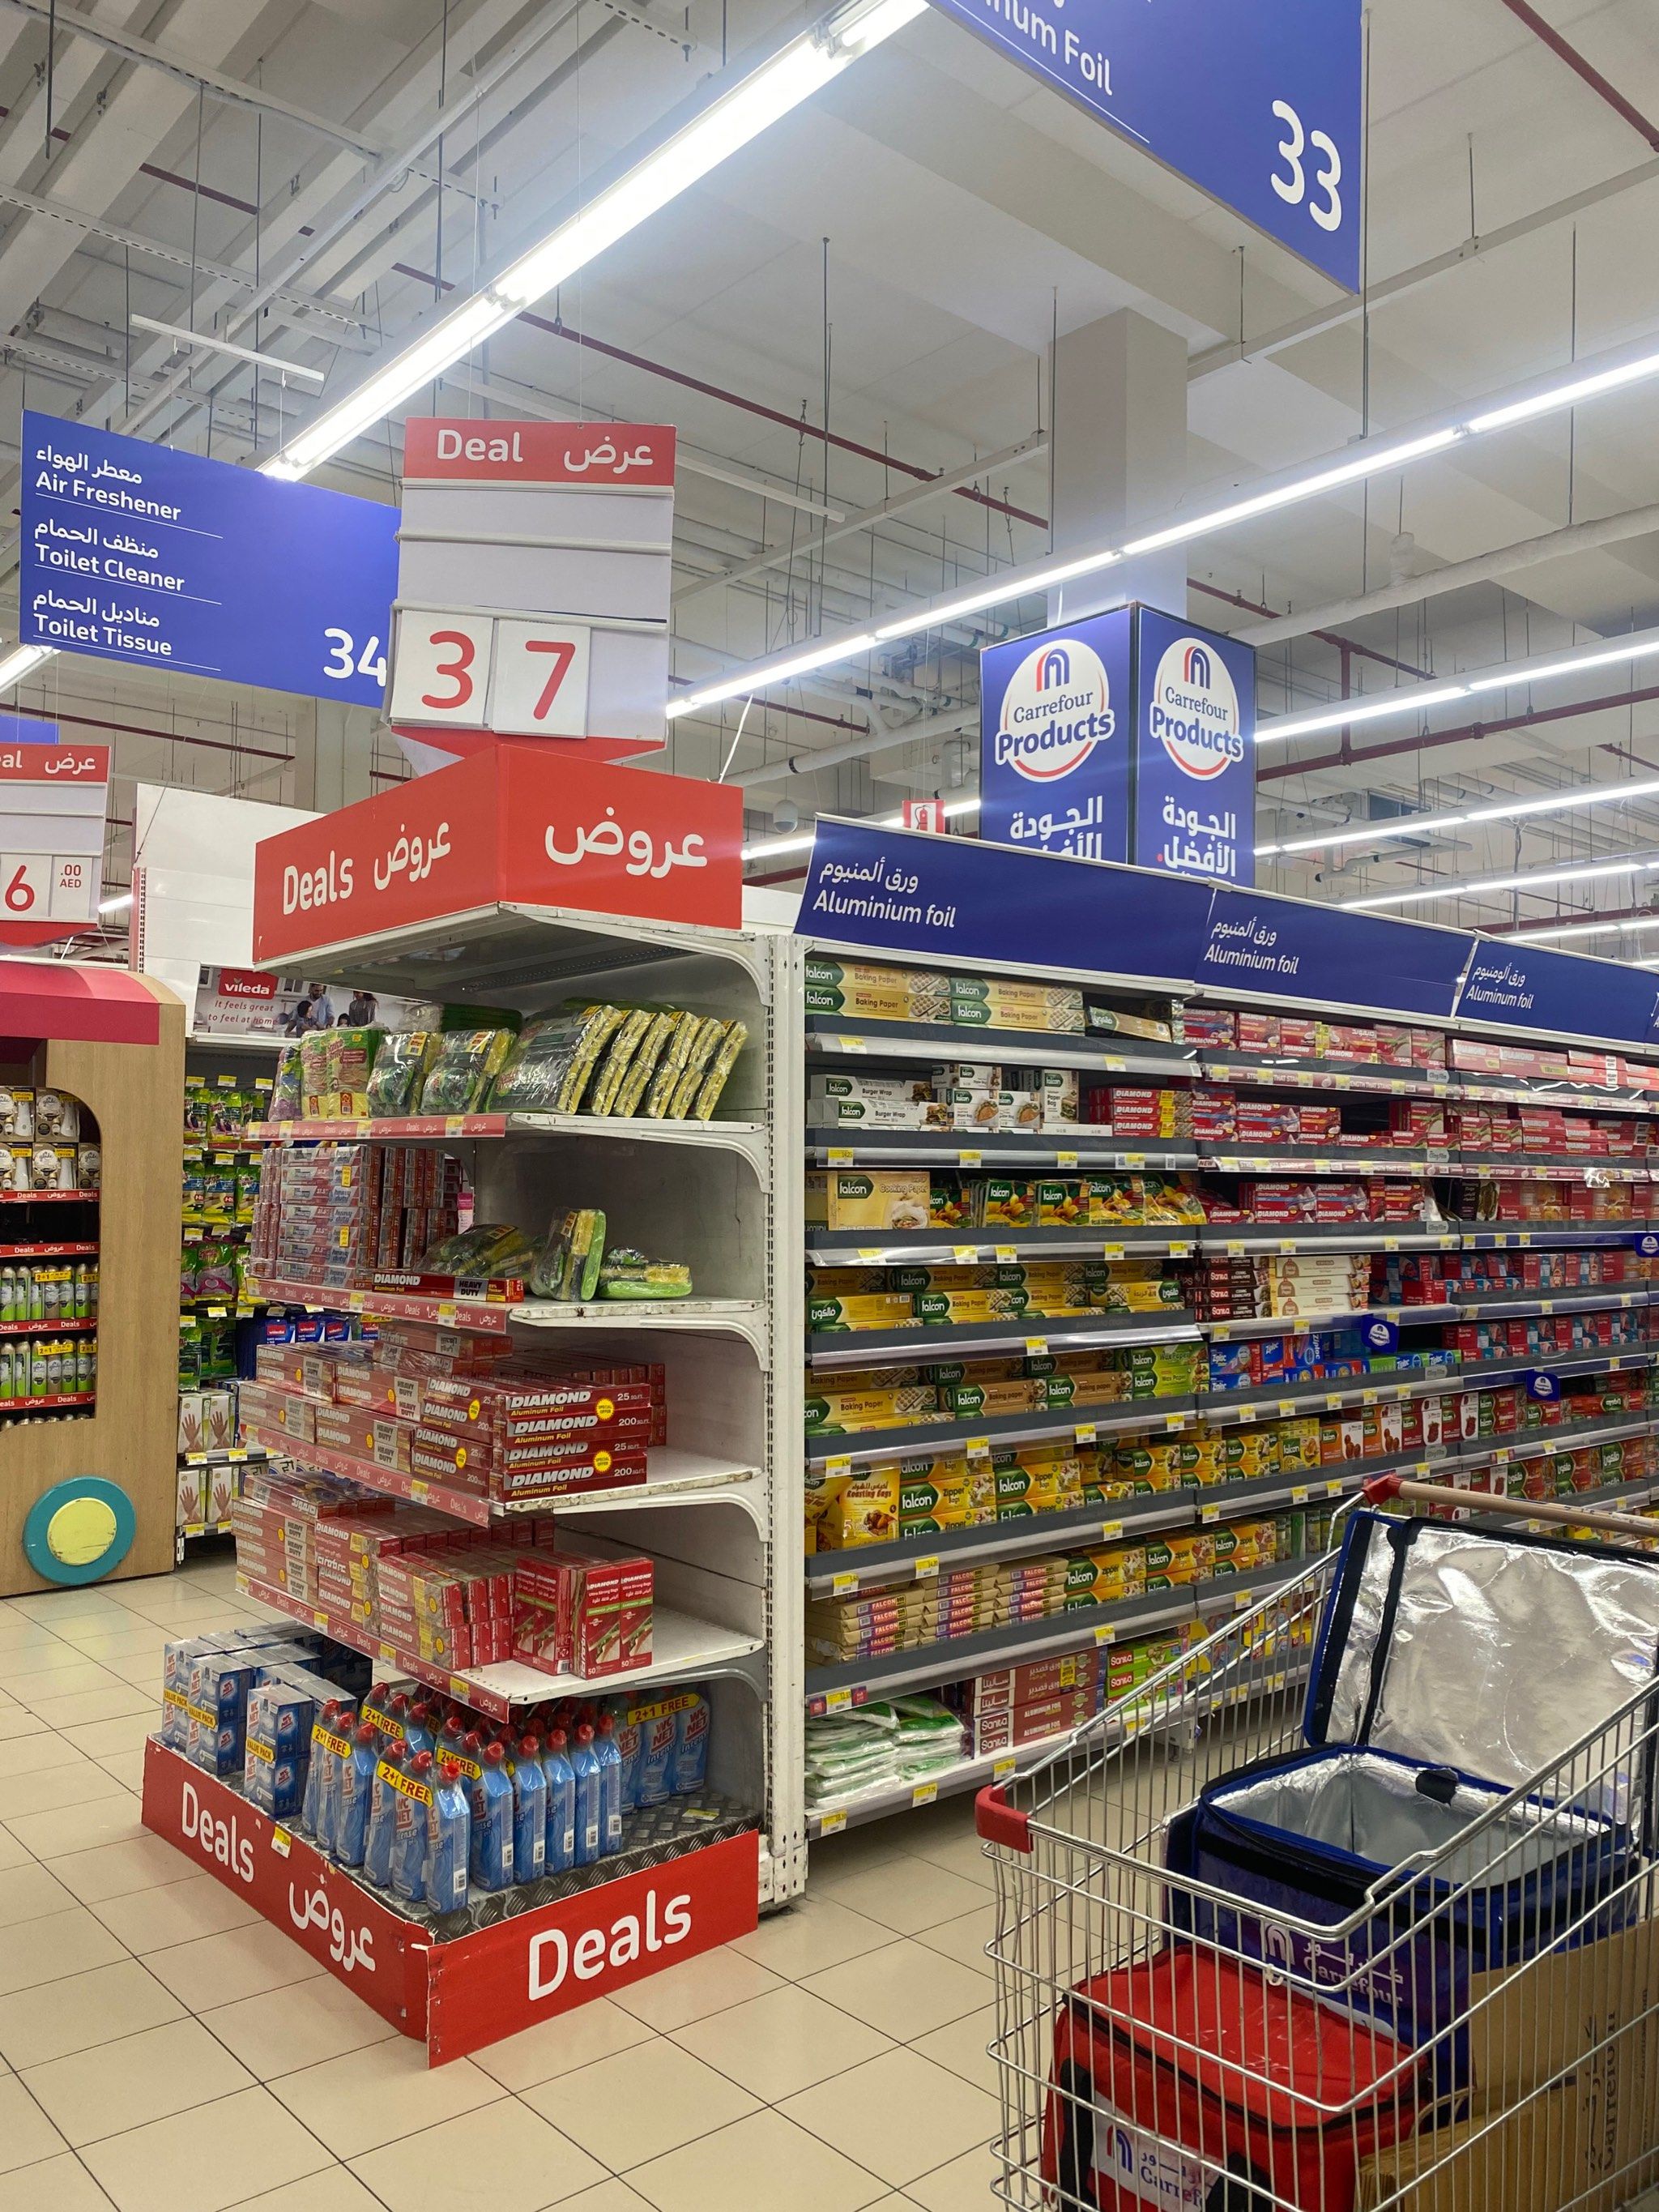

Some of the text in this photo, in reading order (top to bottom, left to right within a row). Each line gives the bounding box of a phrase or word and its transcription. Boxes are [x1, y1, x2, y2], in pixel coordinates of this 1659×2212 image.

[1064, 29, 1112, 96] Foil
[1271, 99, 1342, 232] 33
[437, 429, 523, 463] Deal
[564, 435, 654, 474] عرض
[36, 445, 143, 485] معطر الهواء
[36, 472, 181, 521] Air Freshener
[35, 519, 159, 558] منظف الحمام
[35, 544, 185, 591] Toilet Cleaner
[33, 589, 160, 628] مناديل الحمام
[34, 613, 173, 655] Toilet Tissue
[323, 628, 387, 687] 34
[1013, 692, 1094, 724] Carrefour
[1166, 686, 1228, 721] Carrefour
[999, 713, 1111, 762] Products
[1153, 706, 1241, 758] Products
[45, 752, 96, 775] عرض
[1009, 796, 1103, 840] الجودة
[1162, 796, 1235, 839] الجودة
[544, 805, 708, 878] عروض
[373, 822, 452, 891] عروض
[5, 865, 35, 912] 6
[59, 878, 82, 888] AED
[283, 850, 353, 916] Deals
[885, 872, 919, 894] ورق
[812, 890, 956, 929] Aluminium foil
[1256, 927, 1277, 947] ورق
[1204, 943, 1299, 975] Aluminium foil
[806, 967, 833, 980] falcon
[224, 982, 270, 995] vileda
[955, 983, 980, 996] falcon
[807, 992, 834, 1006] falcon
[855, 997, 878, 1008] Baking
[1466, 984, 1534, 1010] Aluminum foil
[215, 1000, 274, 1012] It feels great
[957, 1006, 982, 1018] falcon
[220, 1014, 239, 1023] feel
[253, 1016, 278, 1025] home
[1115, 1090, 1153, 1099] DIAMOND
[1116, 1106, 1154, 1115] DIAMOND
[1116, 1122, 1154, 1131] DIAMOND
[839, 1184, 867, 1194] falcon
[76, 1244, 95, 1252] Deals
[374, 1274, 420, 1286] DIAMOND
[459, 1280, 482, 1289] HEAVY
[461, 1288, 480, 1296] DUTY
[429, 1379, 471, 1397] DIAMOND
[1049, 1384, 1071, 1396] falcon
[510, 1391, 591, 1407] DIAMOND
[617, 1393, 629, 1401] 25
[957, 1394, 981, 1406] falcon
[424, 1403, 467, 1423] DIAMOND
[511, 1408, 548, 1416] Aluminum
[841, 1400, 883, 1411] Baking Paper
[514, 1416, 598, 1434] DIAMOND
[618, 1417, 637, 1425] 200
[377, 1425, 394, 1435] HEAVY
[379, 1433, 392, 1441] DUTY
[514, 1433, 554, 1444] Aluminum
[614, 1442, 626, 1450] 25
[377, 1446, 394, 1456] HEAVY
[379, 1454, 393, 1463] DUTY
[509, 1442, 588, 1460] DIAMOND
[414, 1453, 457, 1474] DIAMOND
[509, 1460, 546, 1469] Aluminum
[614, 1467, 632, 1475] 200
[512, 1467, 594, 1487] DIAMOND
[1034, 1473, 1052, 1482] Zipper
[511, 1484, 567, 1497] Aluminum Foil
[943, 1487, 965, 1497] Zipper
[1000, 1480, 1025, 1492] falcon
[902, 1494, 932, 1509] falcon
[1148, 1552, 1170, 1565] falcon
[1024, 1569, 1046, 1577] FALCON
[1068, 1570, 1093, 1586] falcon
[951, 1584, 974, 1594] FALCON
[872, 1598, 897, 1610] FALCON
[1021, 1602, 1043, 1611] FALCON
[873, 1612, 898, 1621] FALCON
[951, 1608, 974, 1618] FALCON
[875, 1623, 899, 1634] FALCON
[949, 1620, 972, 1630] FALCON
[871, 1635, 894, 1647] FALCON
[635, 1697, 689, 1721] 2+1 FREE
[690, 1706, 706, 1721] WC
[382, 1719, 402, 1736] FREE
[655, 1716, 672, 1732] WC
[687, 1719, 707, 1736] NET
[653, 1728, 674, 1747] NET
[330, 1737, 347, 1755] FREE
[382, 1766, 431, 1802] 2+1 FREE
[181, 1782, 254, 1883] Deals
[289, 1873, 375, 1972] عروض
[528, 1890, 692, 2001] Deals
